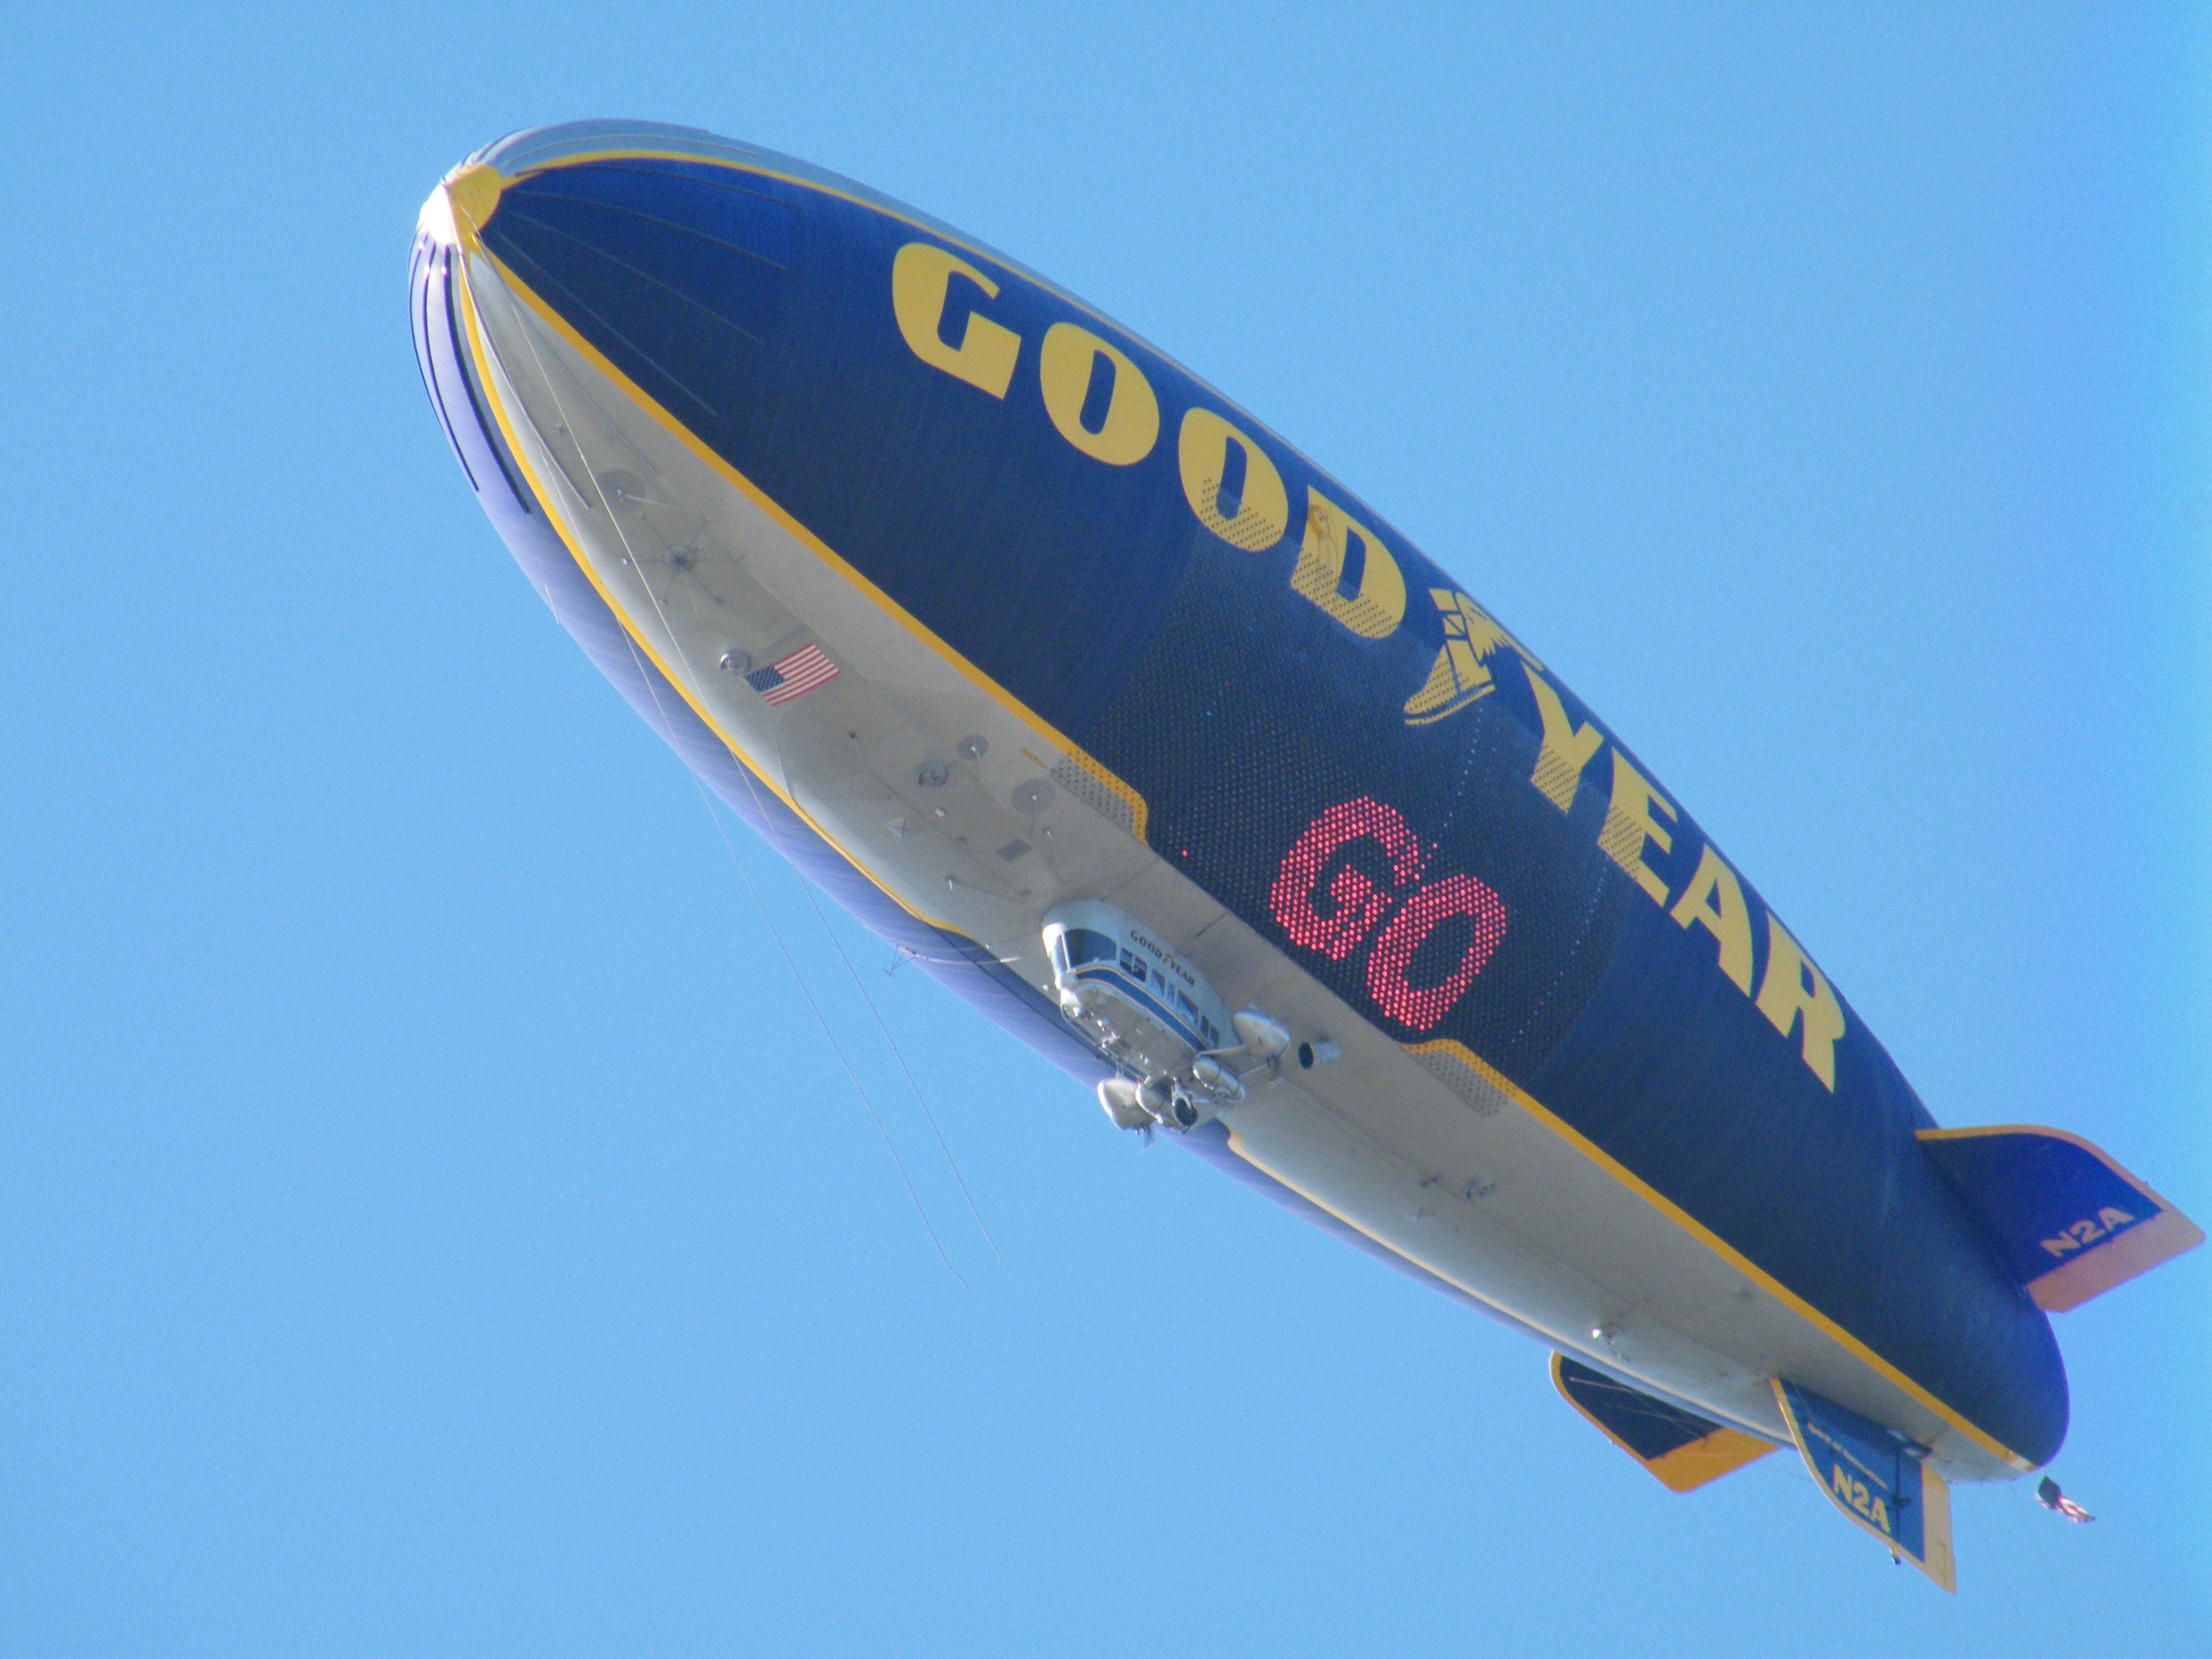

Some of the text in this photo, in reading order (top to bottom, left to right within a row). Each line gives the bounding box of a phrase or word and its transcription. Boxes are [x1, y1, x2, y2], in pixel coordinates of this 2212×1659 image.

[1270, 795, 1506, 1031] GO
[2040, 1207, 2134, 1258] N2A
[1833, 1464, 1891, 1533] N2A
